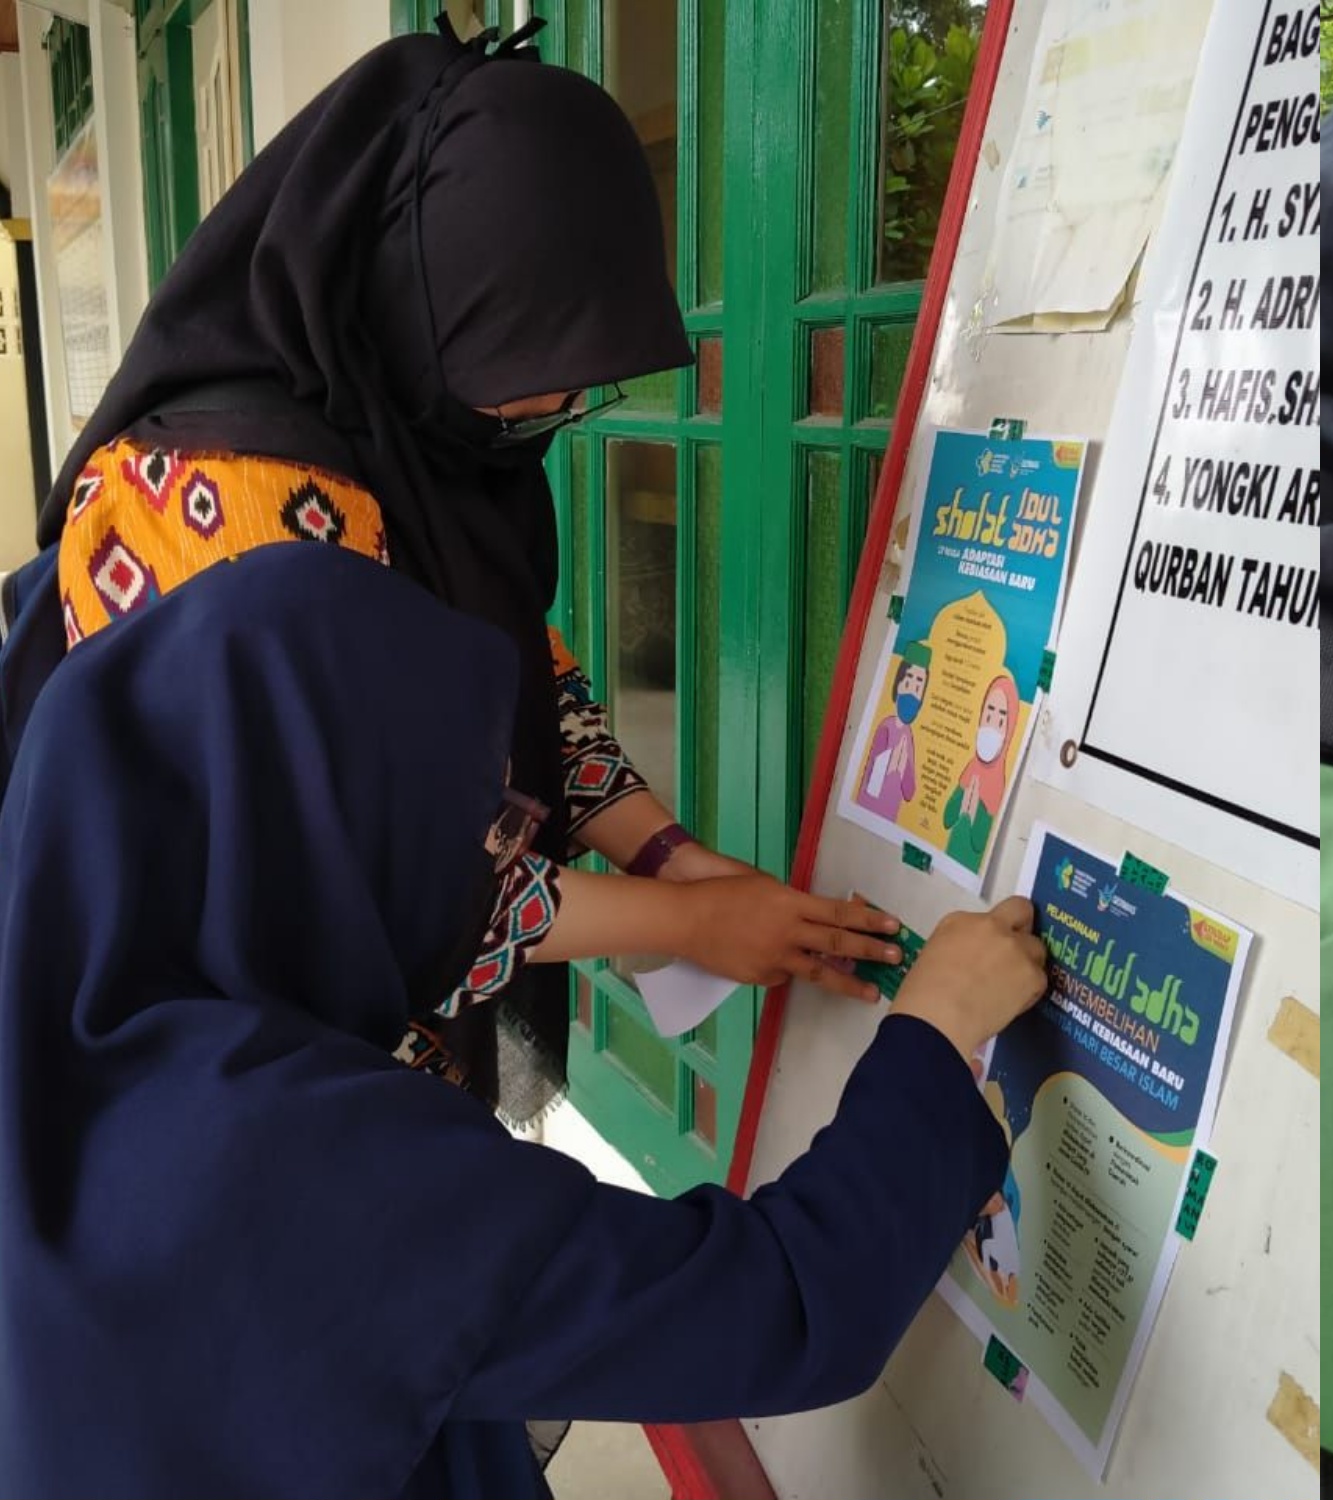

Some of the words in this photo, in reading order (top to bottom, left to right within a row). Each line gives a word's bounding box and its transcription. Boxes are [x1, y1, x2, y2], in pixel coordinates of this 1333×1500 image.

[1218, 192, 1236, 242] 1.
[1243, 188, 1271, 241] H.
[1190, 279, 1213, 331] 2.
[1219, 279, 1246, 330] H.
[1172, 368, 1192, 420] 3.
[1152, 455, 1171, 506] 4.
[1180, 456, 1281, 519] YONGKI
[1134, 540, 1235, 608] QURBAN
[1099, 1043, 1137, 1083] BESAR
[1138, 1073, 1180, 1111] ISLAM
[1151, 1061, 1184, 1090] BARU
